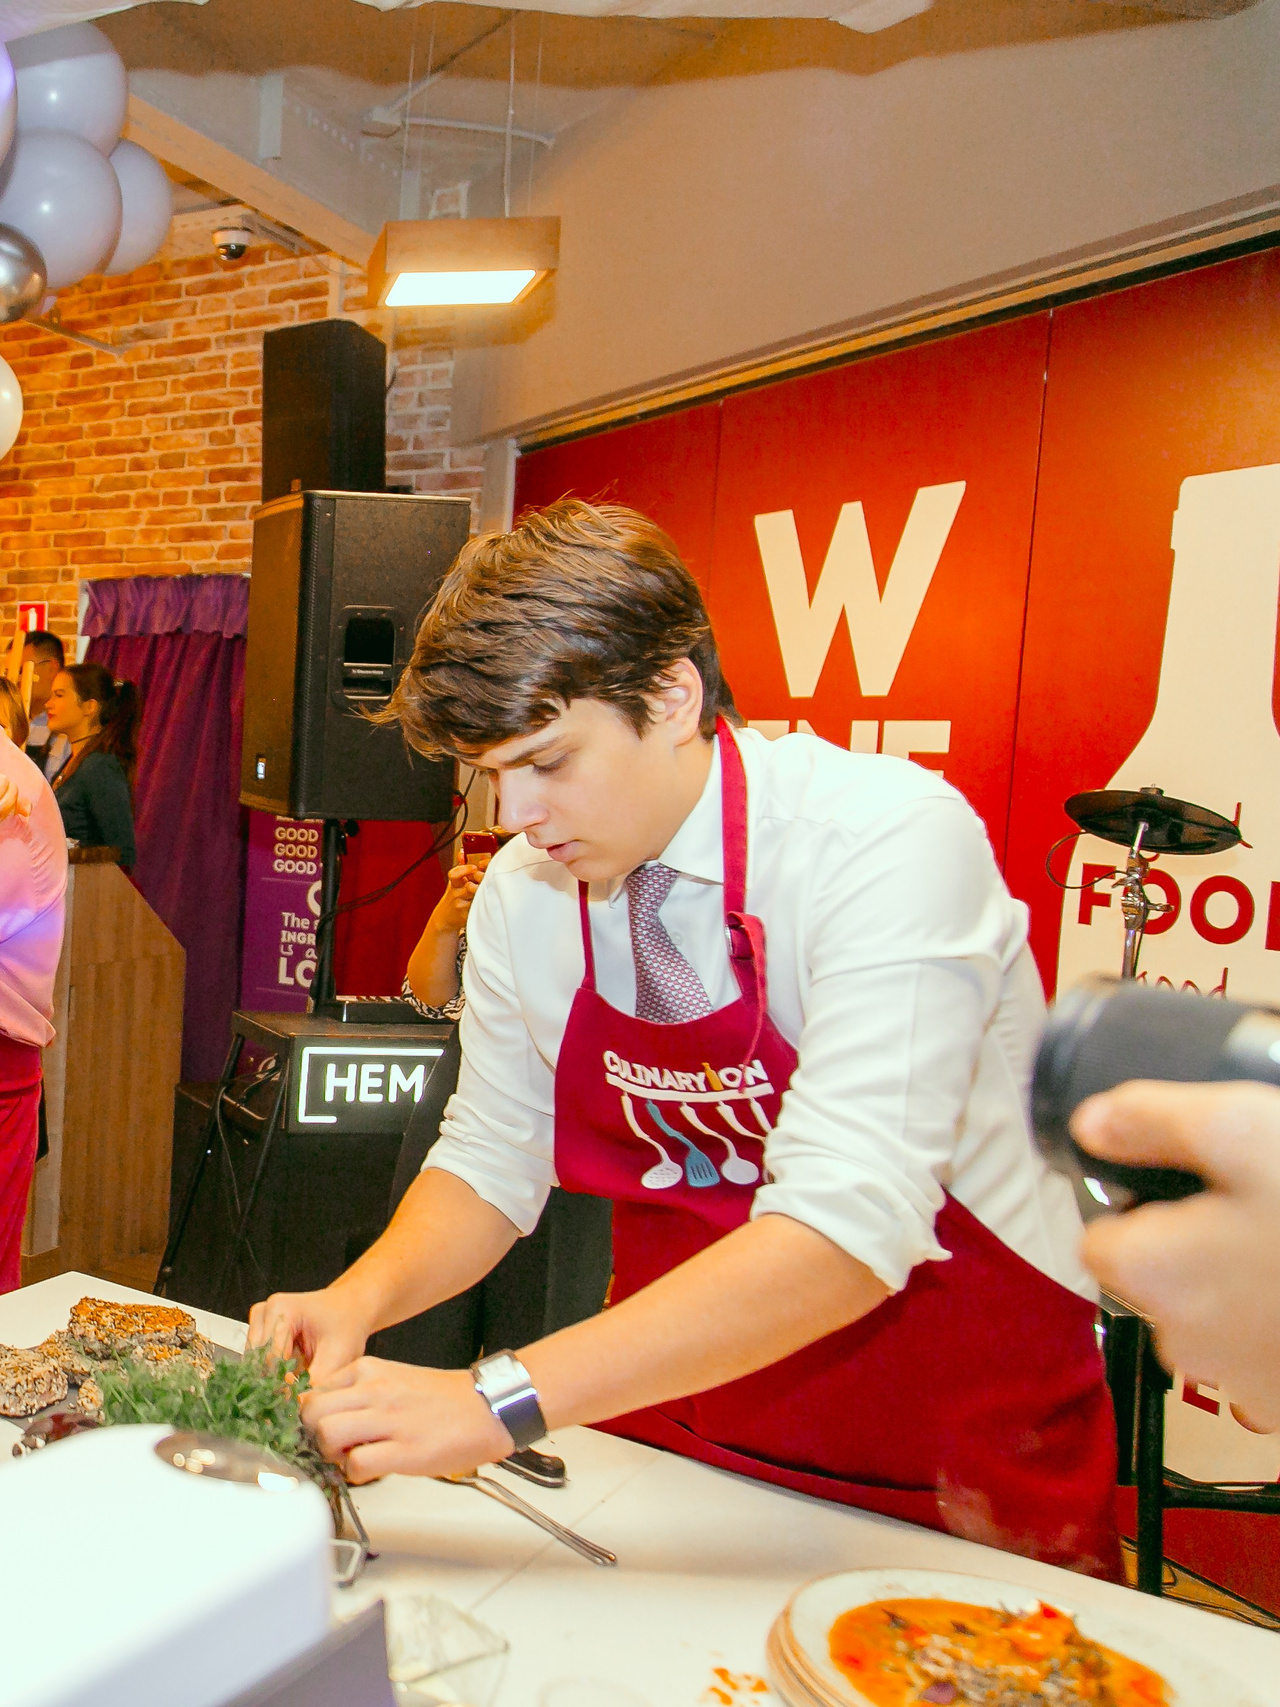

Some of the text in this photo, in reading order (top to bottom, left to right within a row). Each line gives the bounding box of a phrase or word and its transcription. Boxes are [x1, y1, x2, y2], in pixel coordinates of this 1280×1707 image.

[754, 480, 967, 699] W
[274, 826, 319, 843] GOOD
[274, 842, 318, 859] GOOD
[273, 858, 317, 875] GOOD
[1078, 863, 1280, 951] FOO
[282, 911, 310, 930] The
